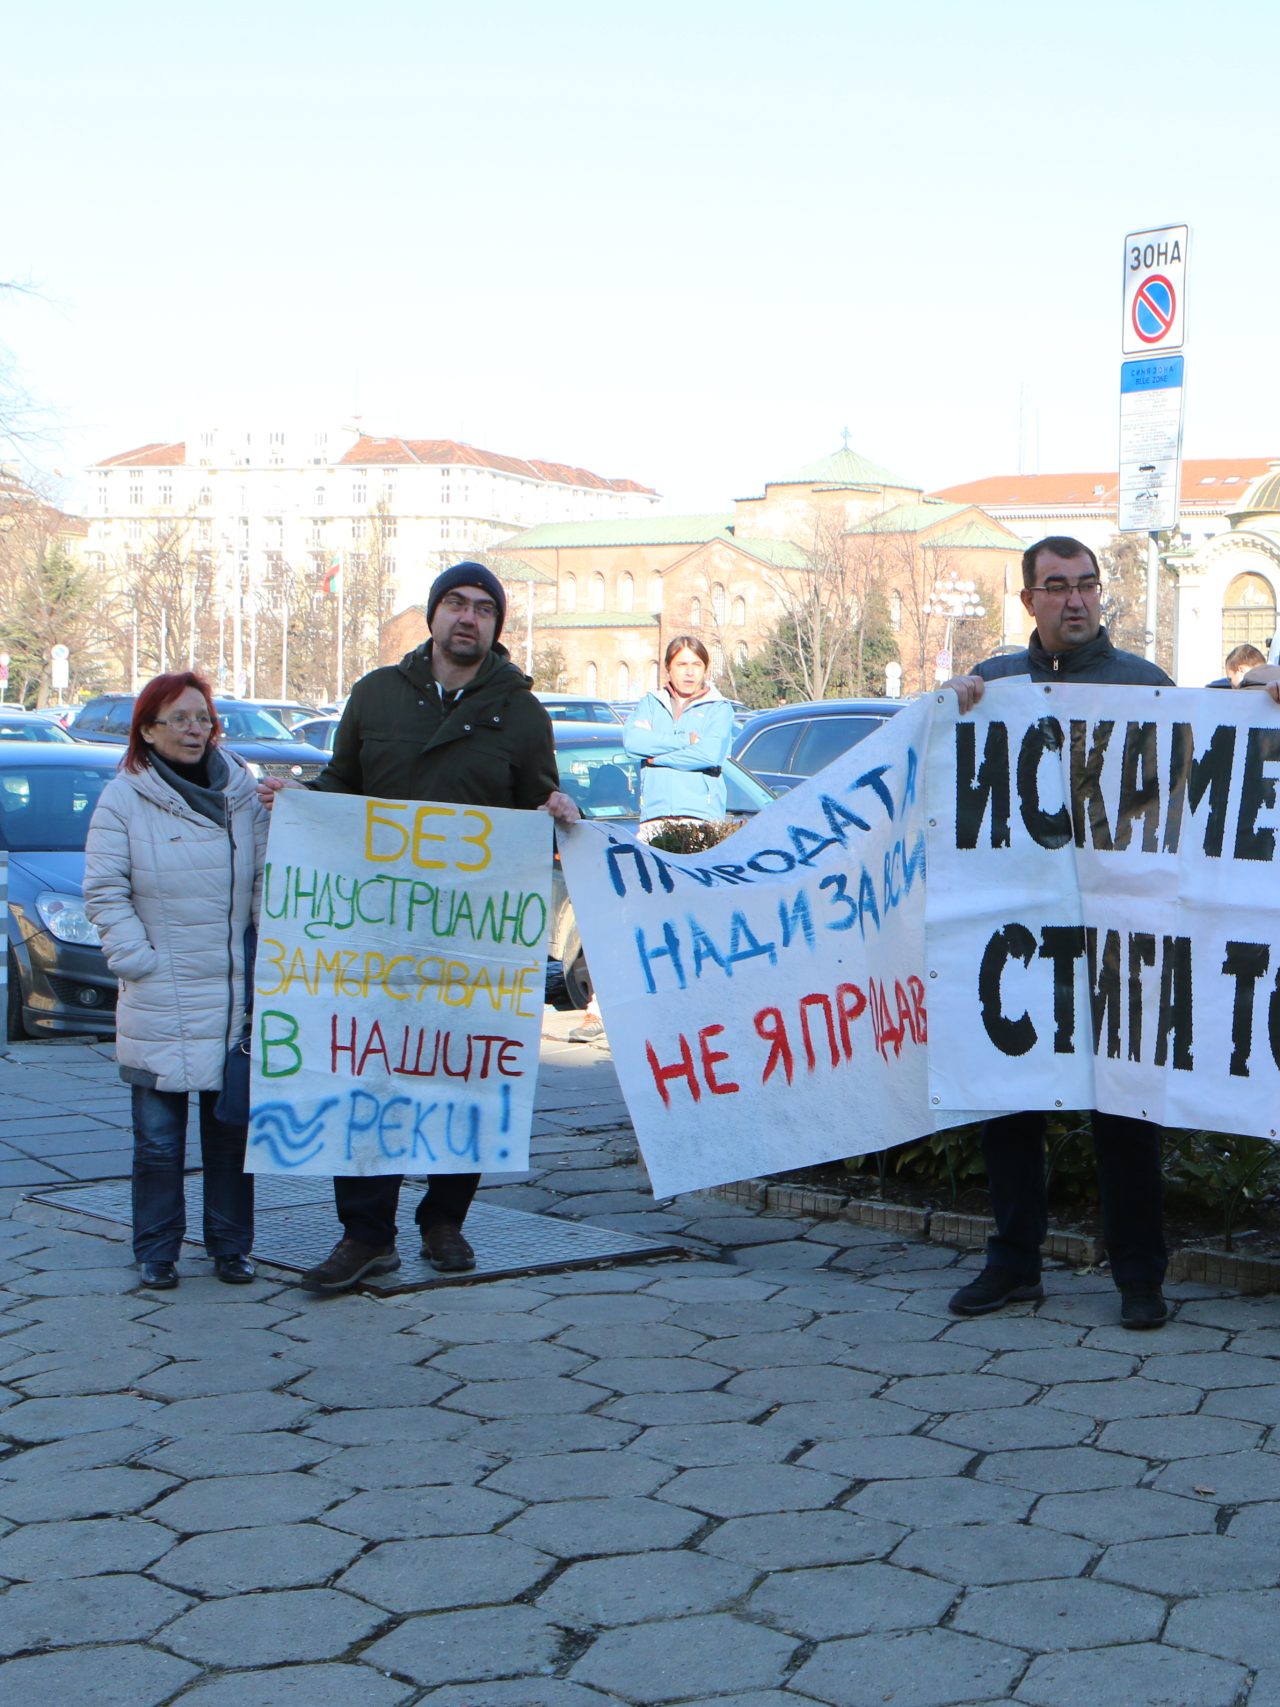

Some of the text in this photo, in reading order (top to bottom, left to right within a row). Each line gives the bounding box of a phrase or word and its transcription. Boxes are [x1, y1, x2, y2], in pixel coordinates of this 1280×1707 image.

[1130, 240, 1182, 271] ЗОНА
[365, 799, 493, 872] БЕЗ
[264, 862, 547, 948] ИНДУСТРИАЛНО
[257, 938, 542, 1018] ЗАМЪРСЯВАНЕ
[978, 923, 1194, 1071] СТИГА
[261, 1010, 526, 1082] В НАШИТЕ
[645, 1024, 739, 1108] НЕ
[754, 1007, 793, 1086] Я
[346, 1084, 511, 1163] РЕКИ!
